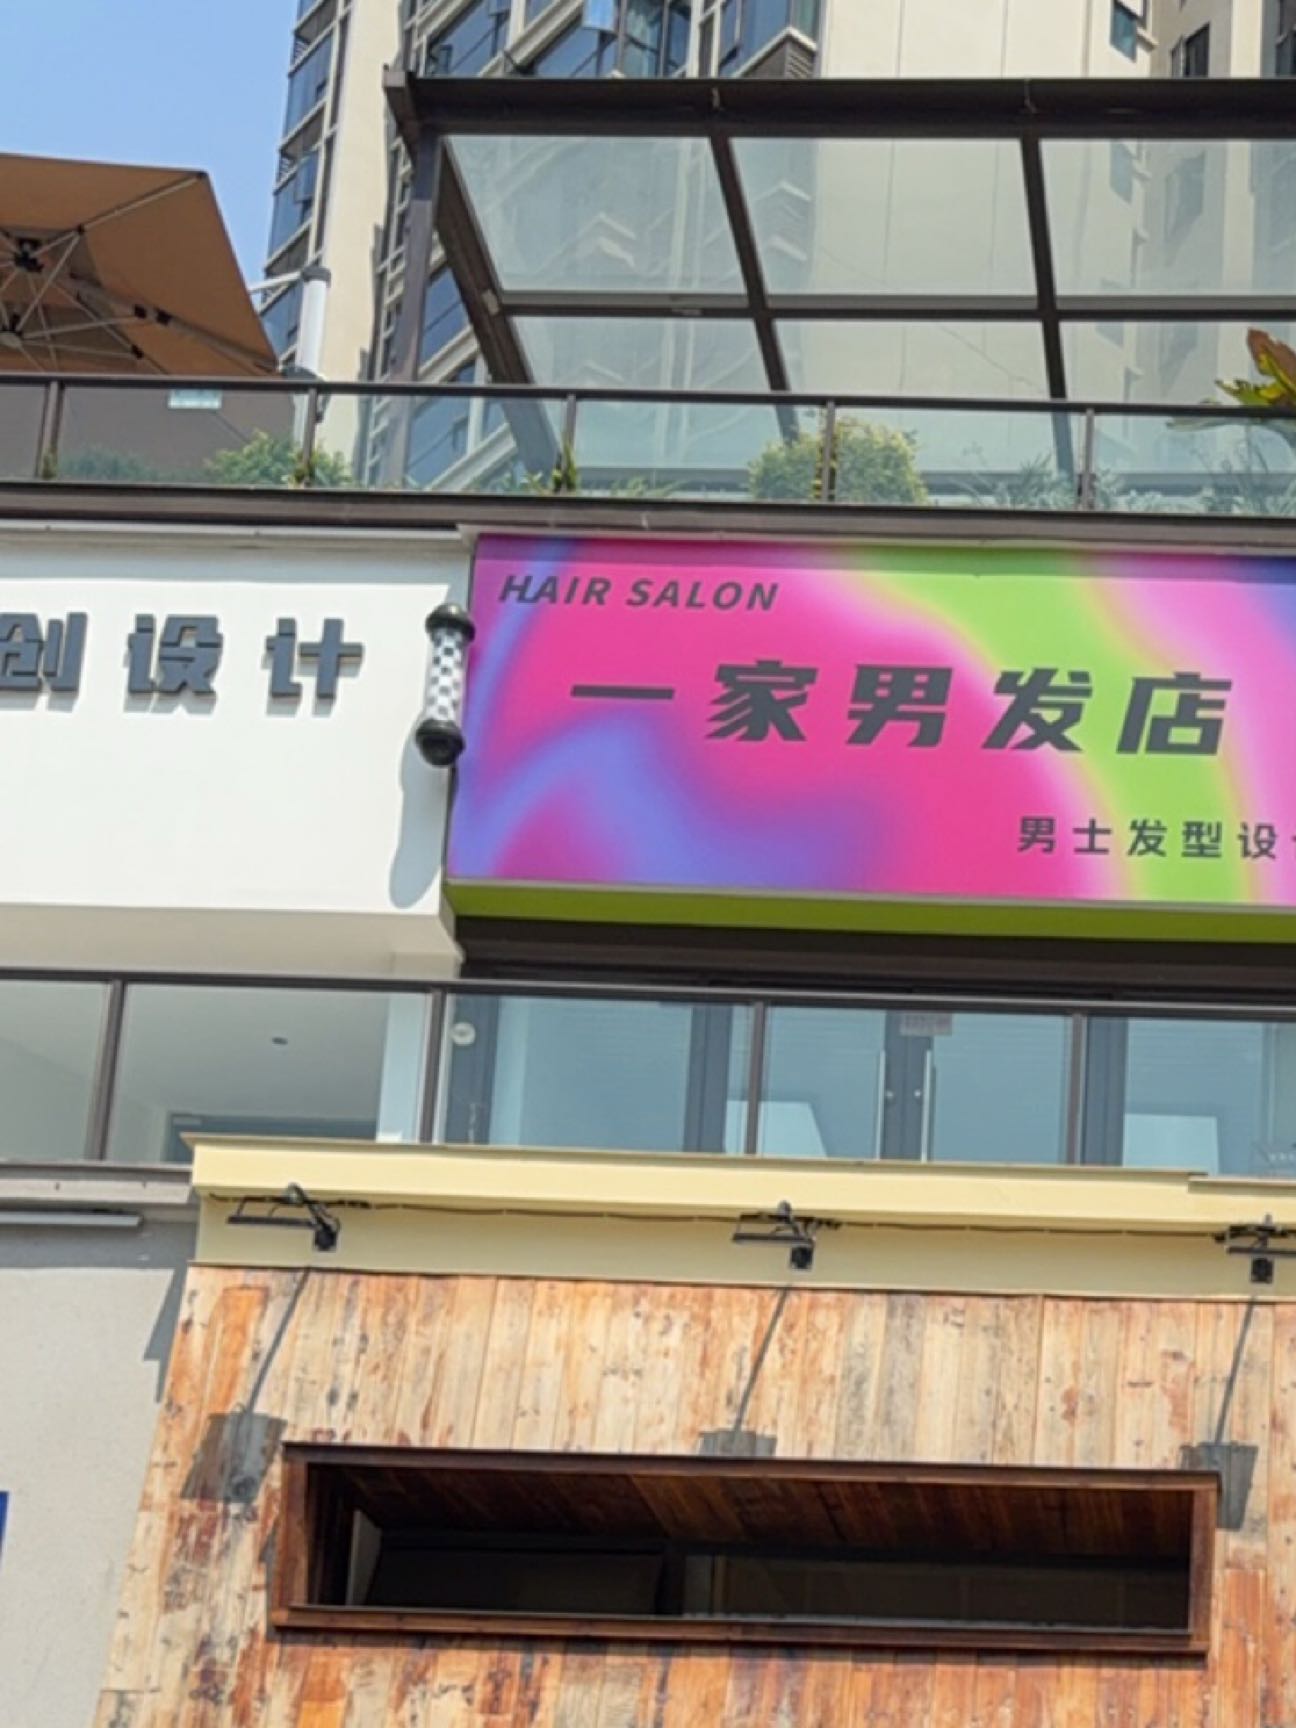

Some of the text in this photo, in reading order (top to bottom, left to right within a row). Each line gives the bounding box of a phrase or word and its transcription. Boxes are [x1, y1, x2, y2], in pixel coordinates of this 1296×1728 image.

[497, 573, 780, 613] HAIR SALON
[570, 658, 1233, 757] 一家男发店
